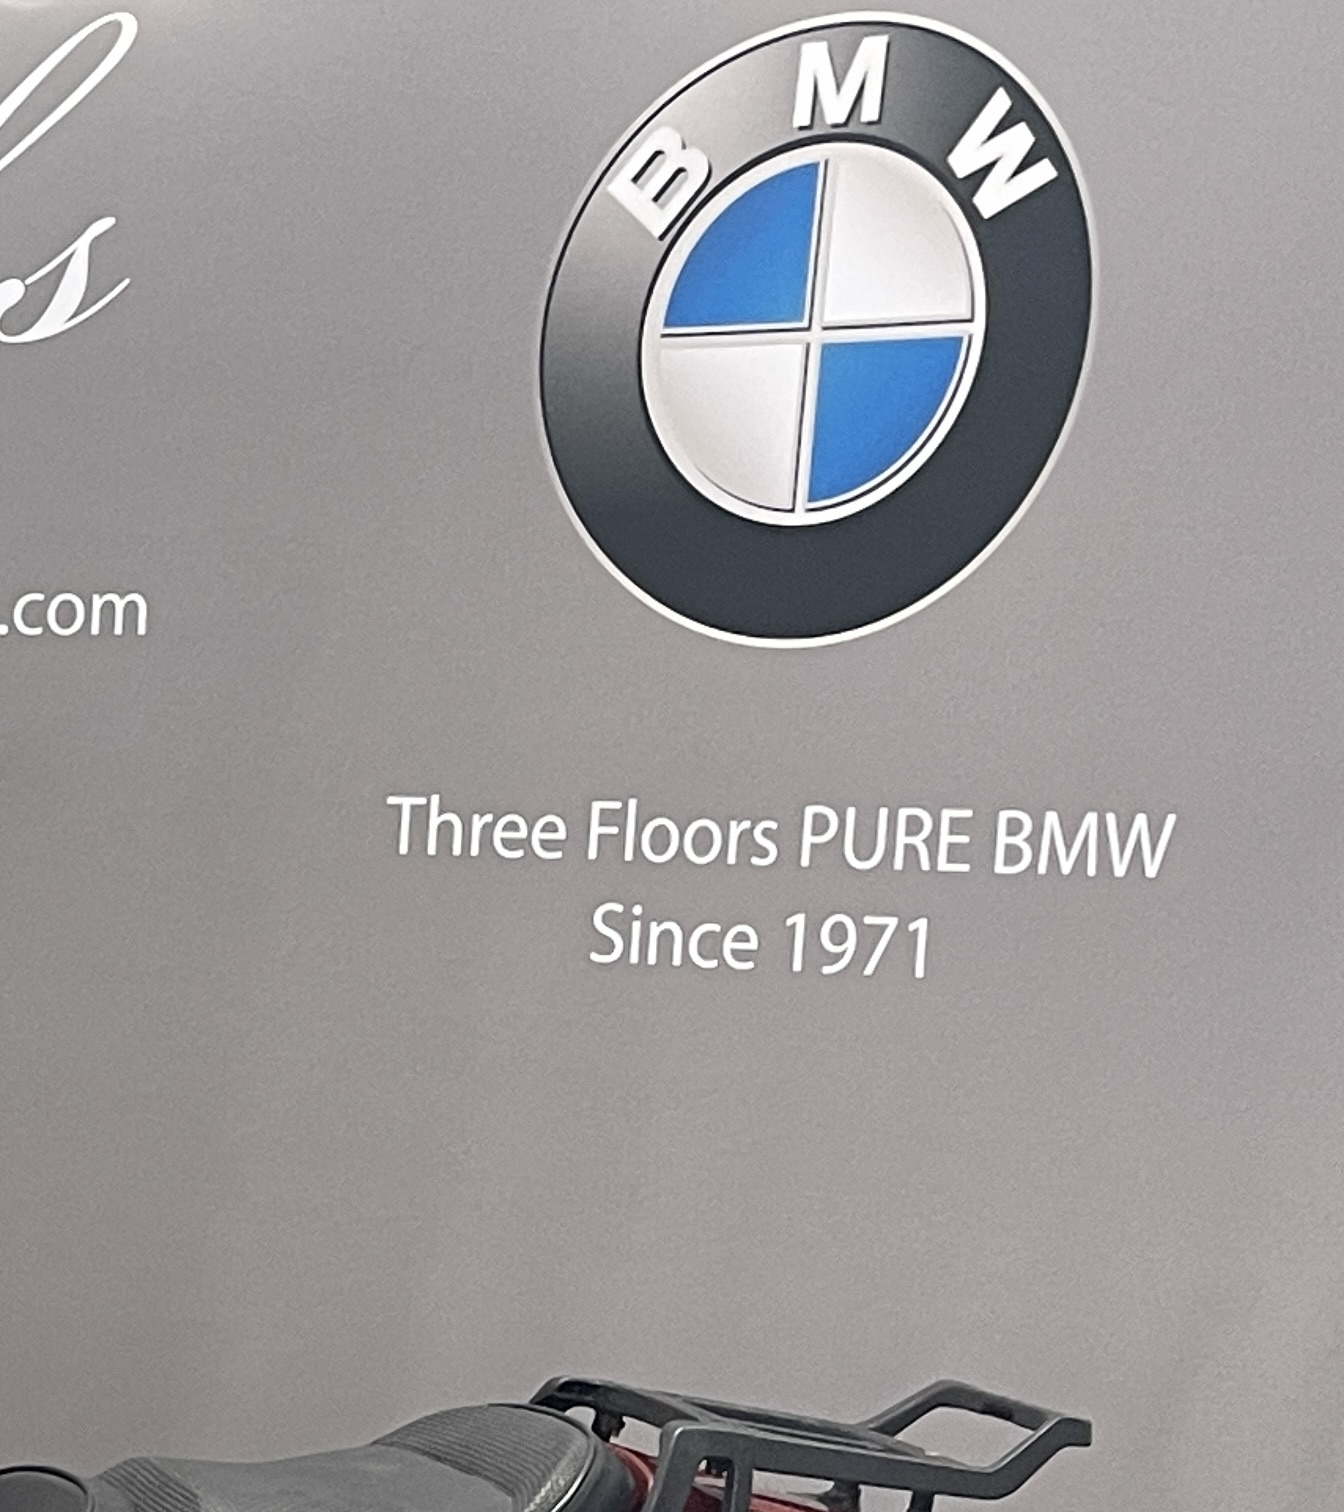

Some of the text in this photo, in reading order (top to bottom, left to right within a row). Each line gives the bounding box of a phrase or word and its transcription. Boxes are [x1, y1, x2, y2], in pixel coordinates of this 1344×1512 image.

[606, 34, 1059, 241] BMW
[386, 794, 1179, 881] Three Floors PURE BMW
[589, 902, 932, 981] Since 1971
